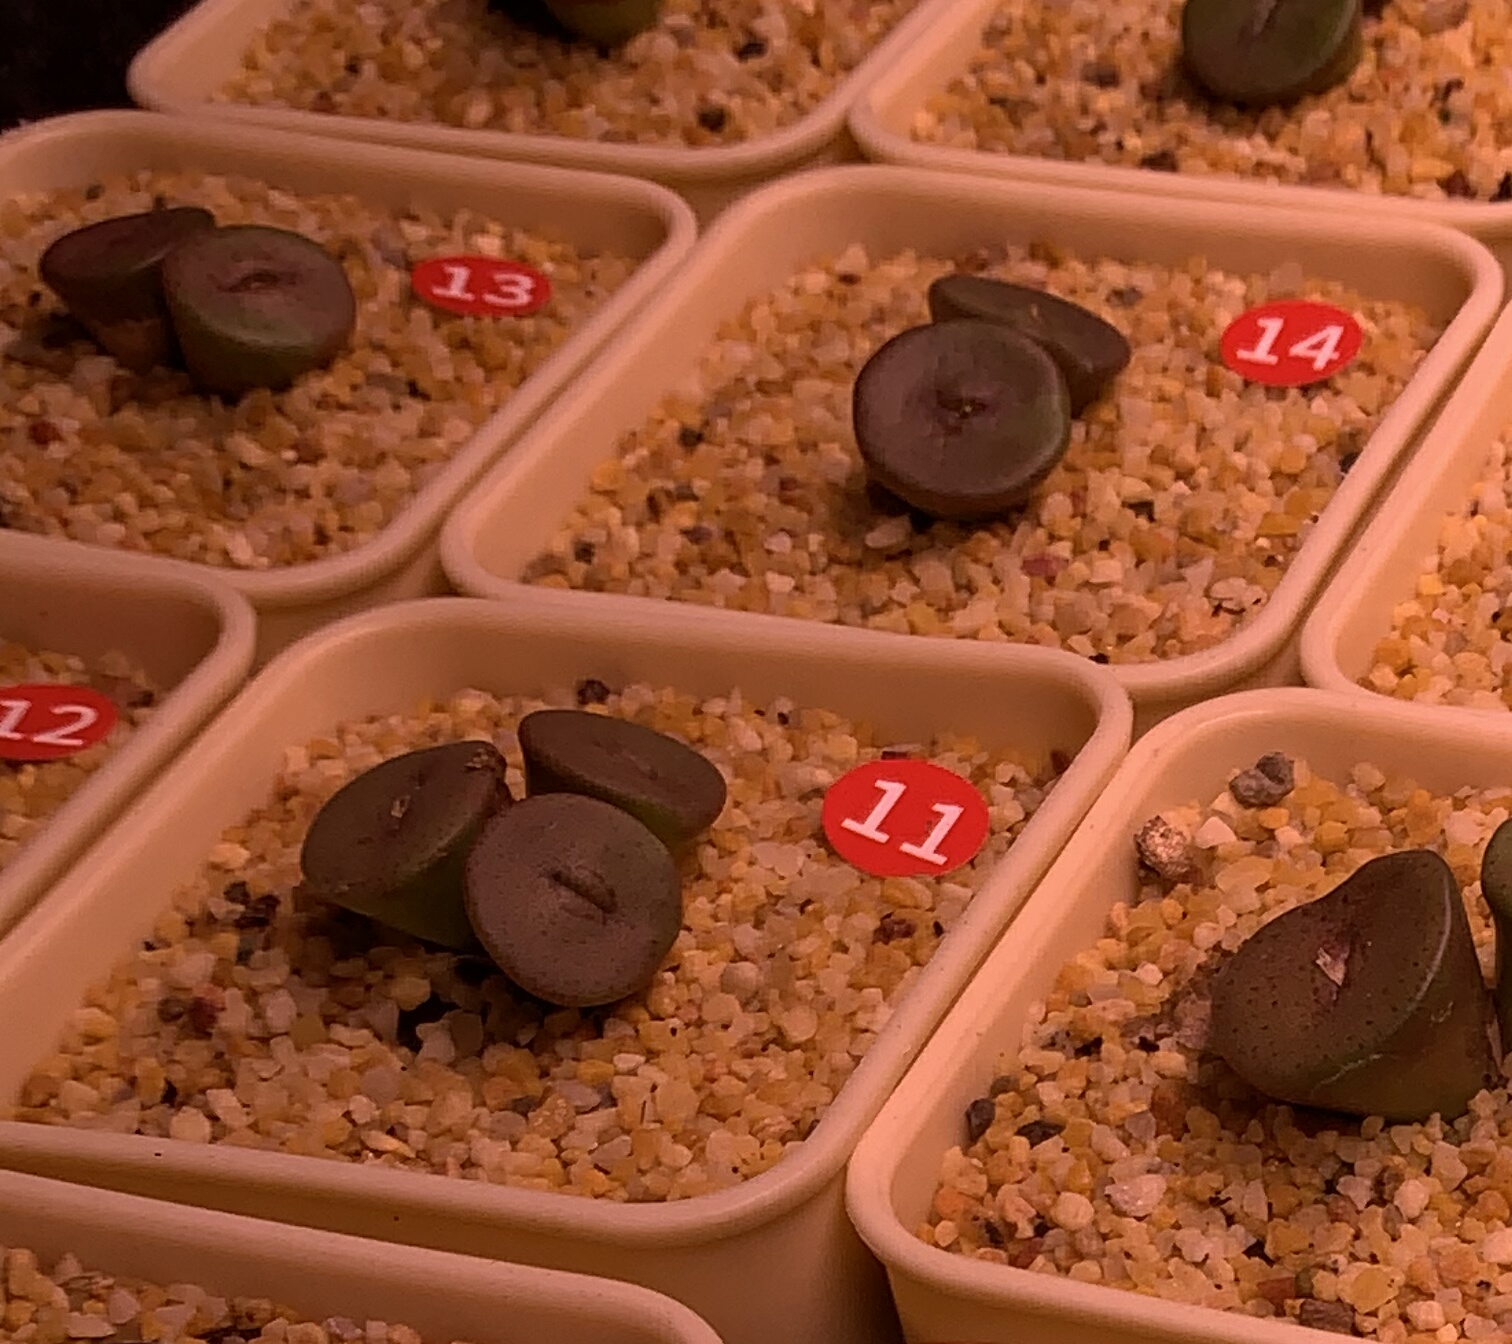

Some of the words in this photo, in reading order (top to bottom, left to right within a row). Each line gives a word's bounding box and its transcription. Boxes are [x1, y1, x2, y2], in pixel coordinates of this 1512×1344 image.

[426, 265, 534, 305] 13
[1236, 317, 1343, 370] 14
[0, 699, 98, 746] 12
[840, 778, 964, 866] 11
